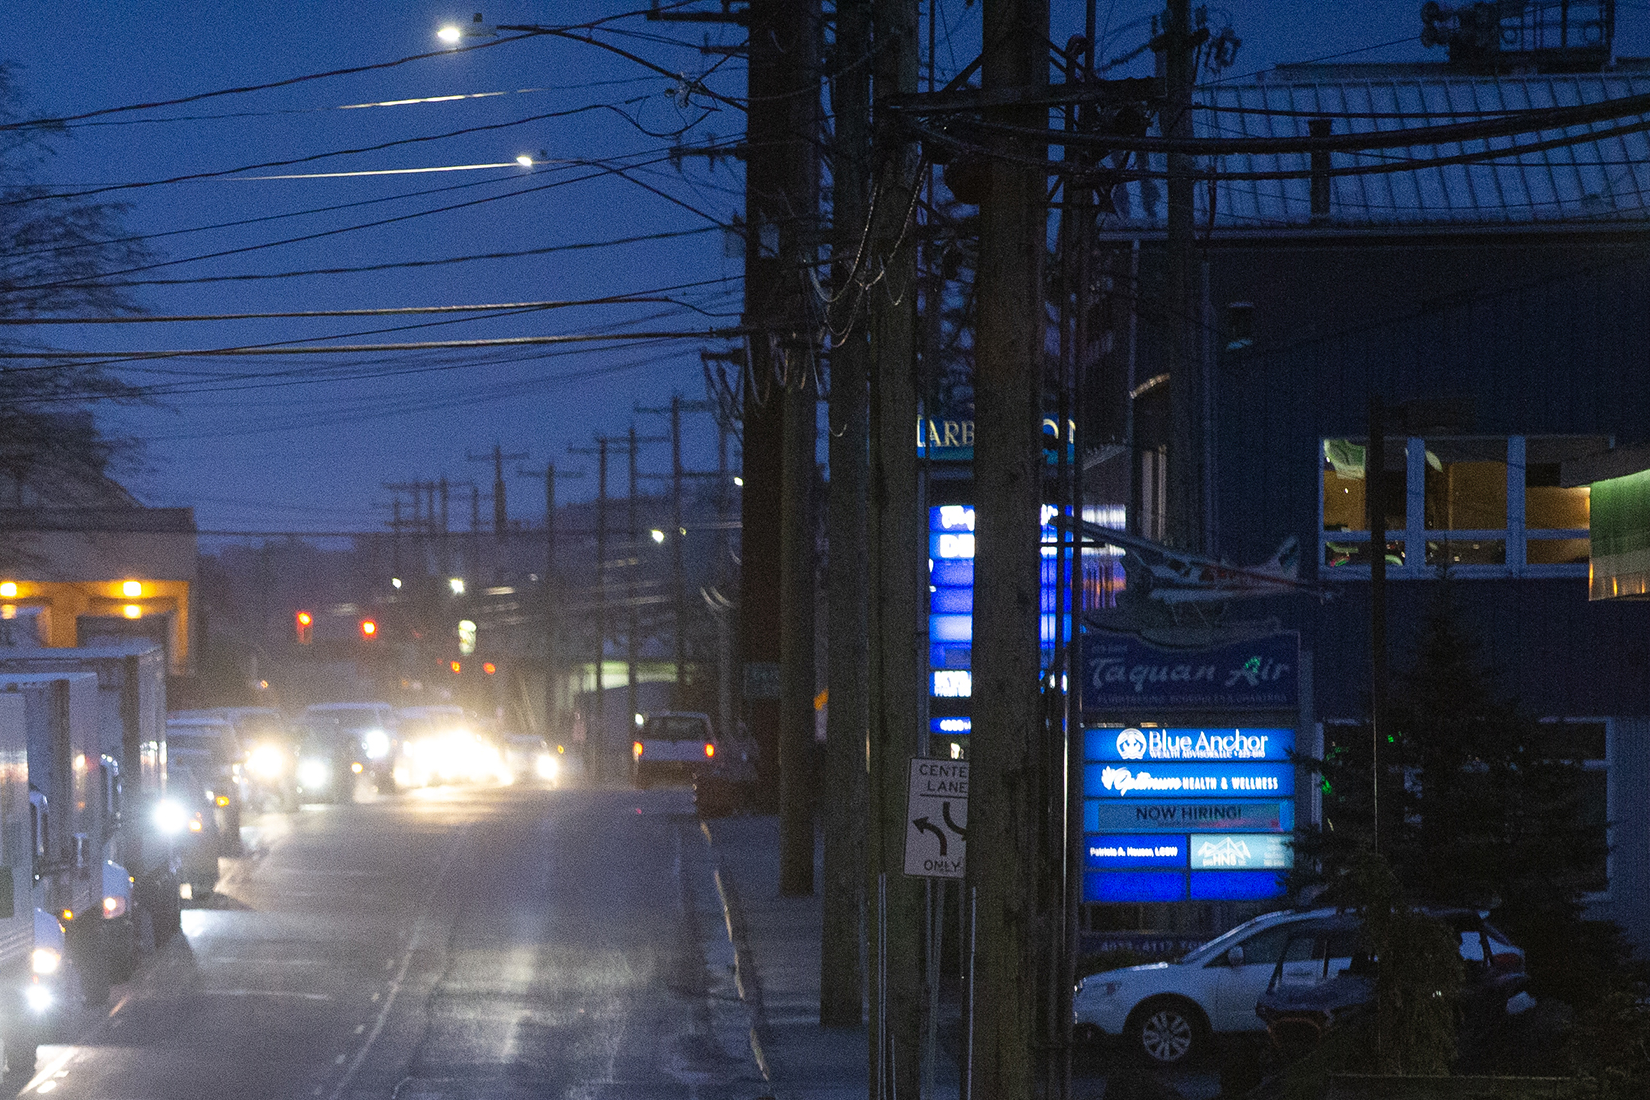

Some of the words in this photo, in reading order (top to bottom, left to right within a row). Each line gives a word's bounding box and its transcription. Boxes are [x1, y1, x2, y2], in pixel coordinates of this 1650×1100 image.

[1088, 657, 1217, 693] Taquan
[1224, 656, 1291, 686] Air
[1148, 728, 1192, 752] Blue
[1195, 728, 1269, 752] Anchor
[919, 763, 968, 779] CENTE
[927, 781, 968, 794] LANE
[1182, 776, 1217, 790] HEALTH
[1220, 777, 1228, 790] &
[1231, 777, 1279, 790] WELLNESS
[1136, 806, 1177, 820] NOW
[1181, 806, 1242, 820] HIRING!
[923, 859, 962, 873] ONLY
